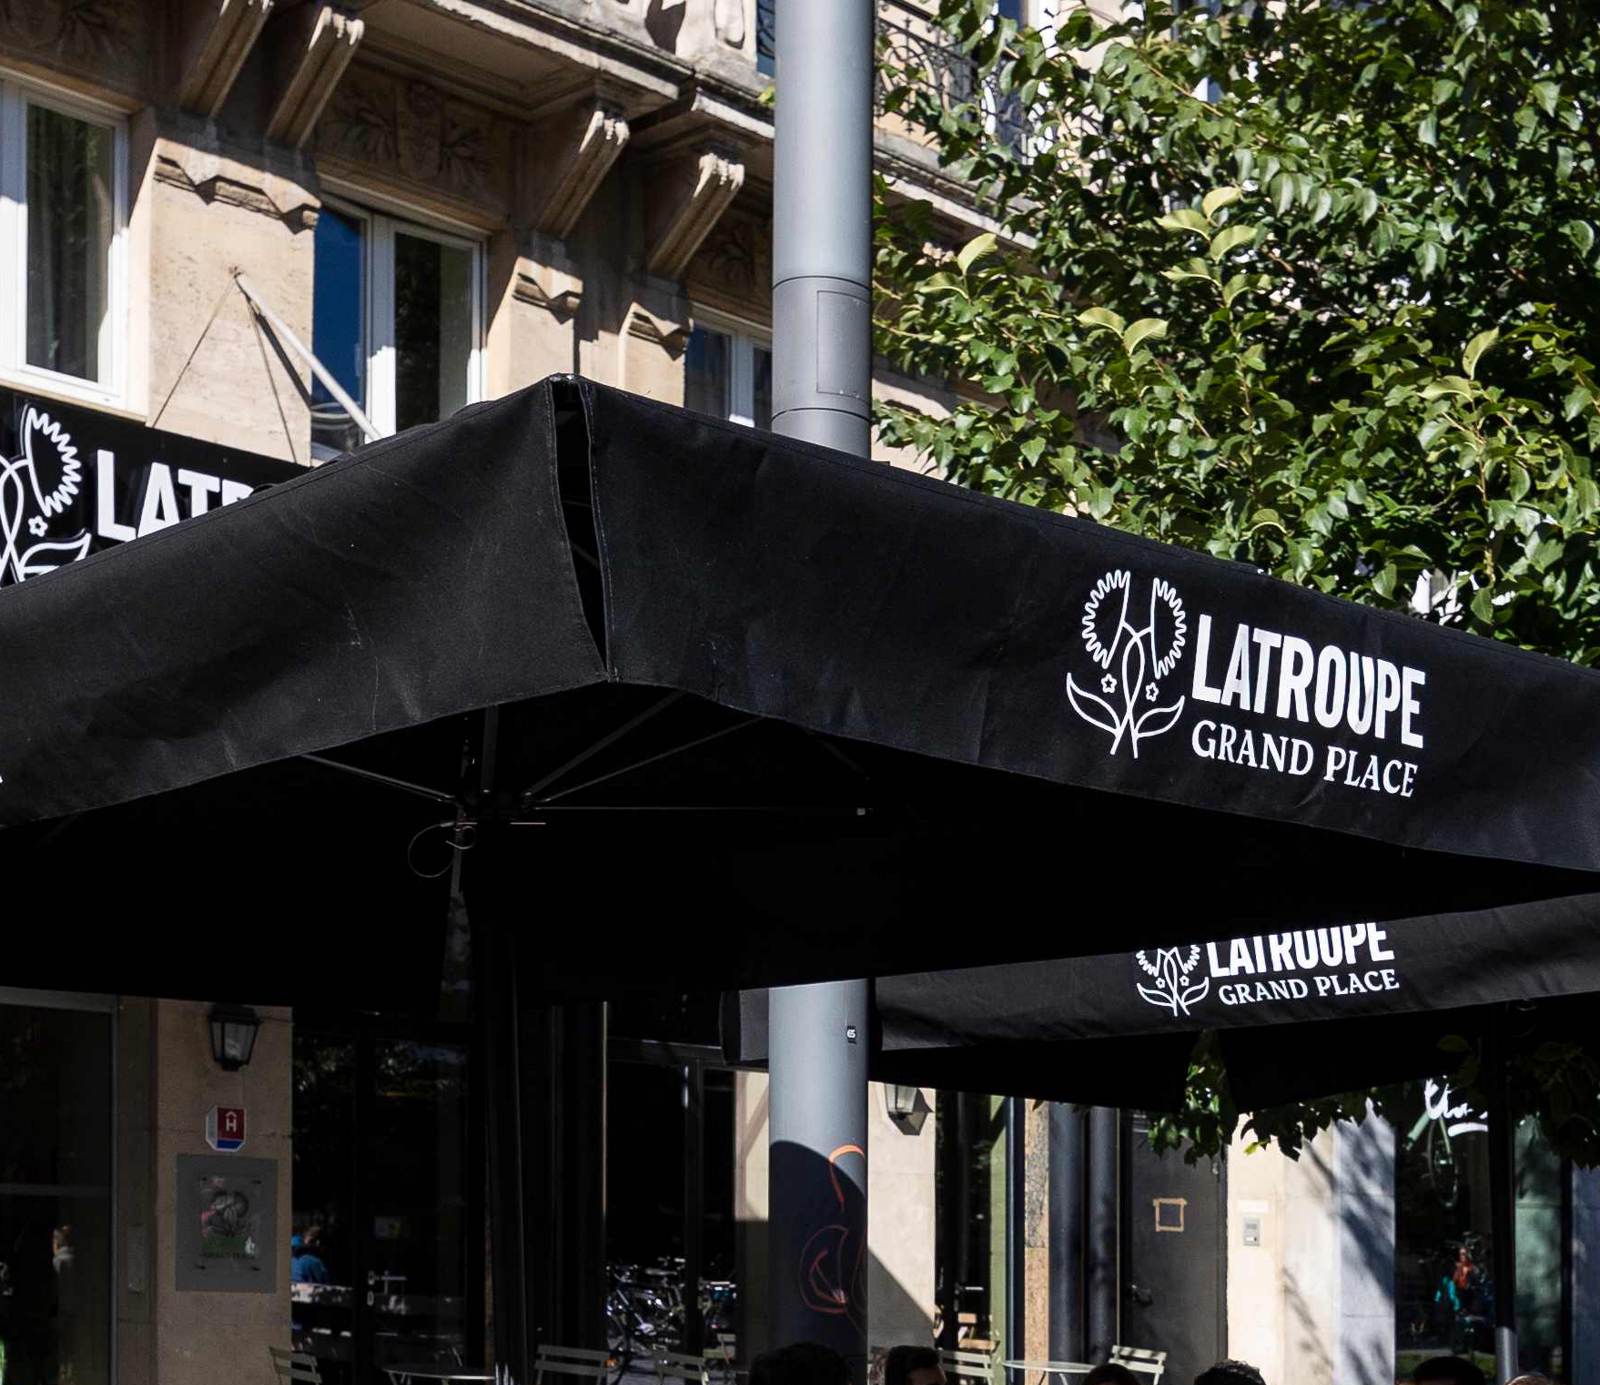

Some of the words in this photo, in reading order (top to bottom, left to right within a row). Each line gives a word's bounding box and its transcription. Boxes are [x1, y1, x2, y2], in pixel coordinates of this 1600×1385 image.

[97, 449, 254, 542] LAT
[1192, 614, 1425, 748] LATROUPE
[1192, 720, 1313, 775] GRAND
[1324, 746, 1418, 797] PLACE
[1219, 979, 1308, 1005] GRAND
[1313, 969, 1400, 996] PLACE
